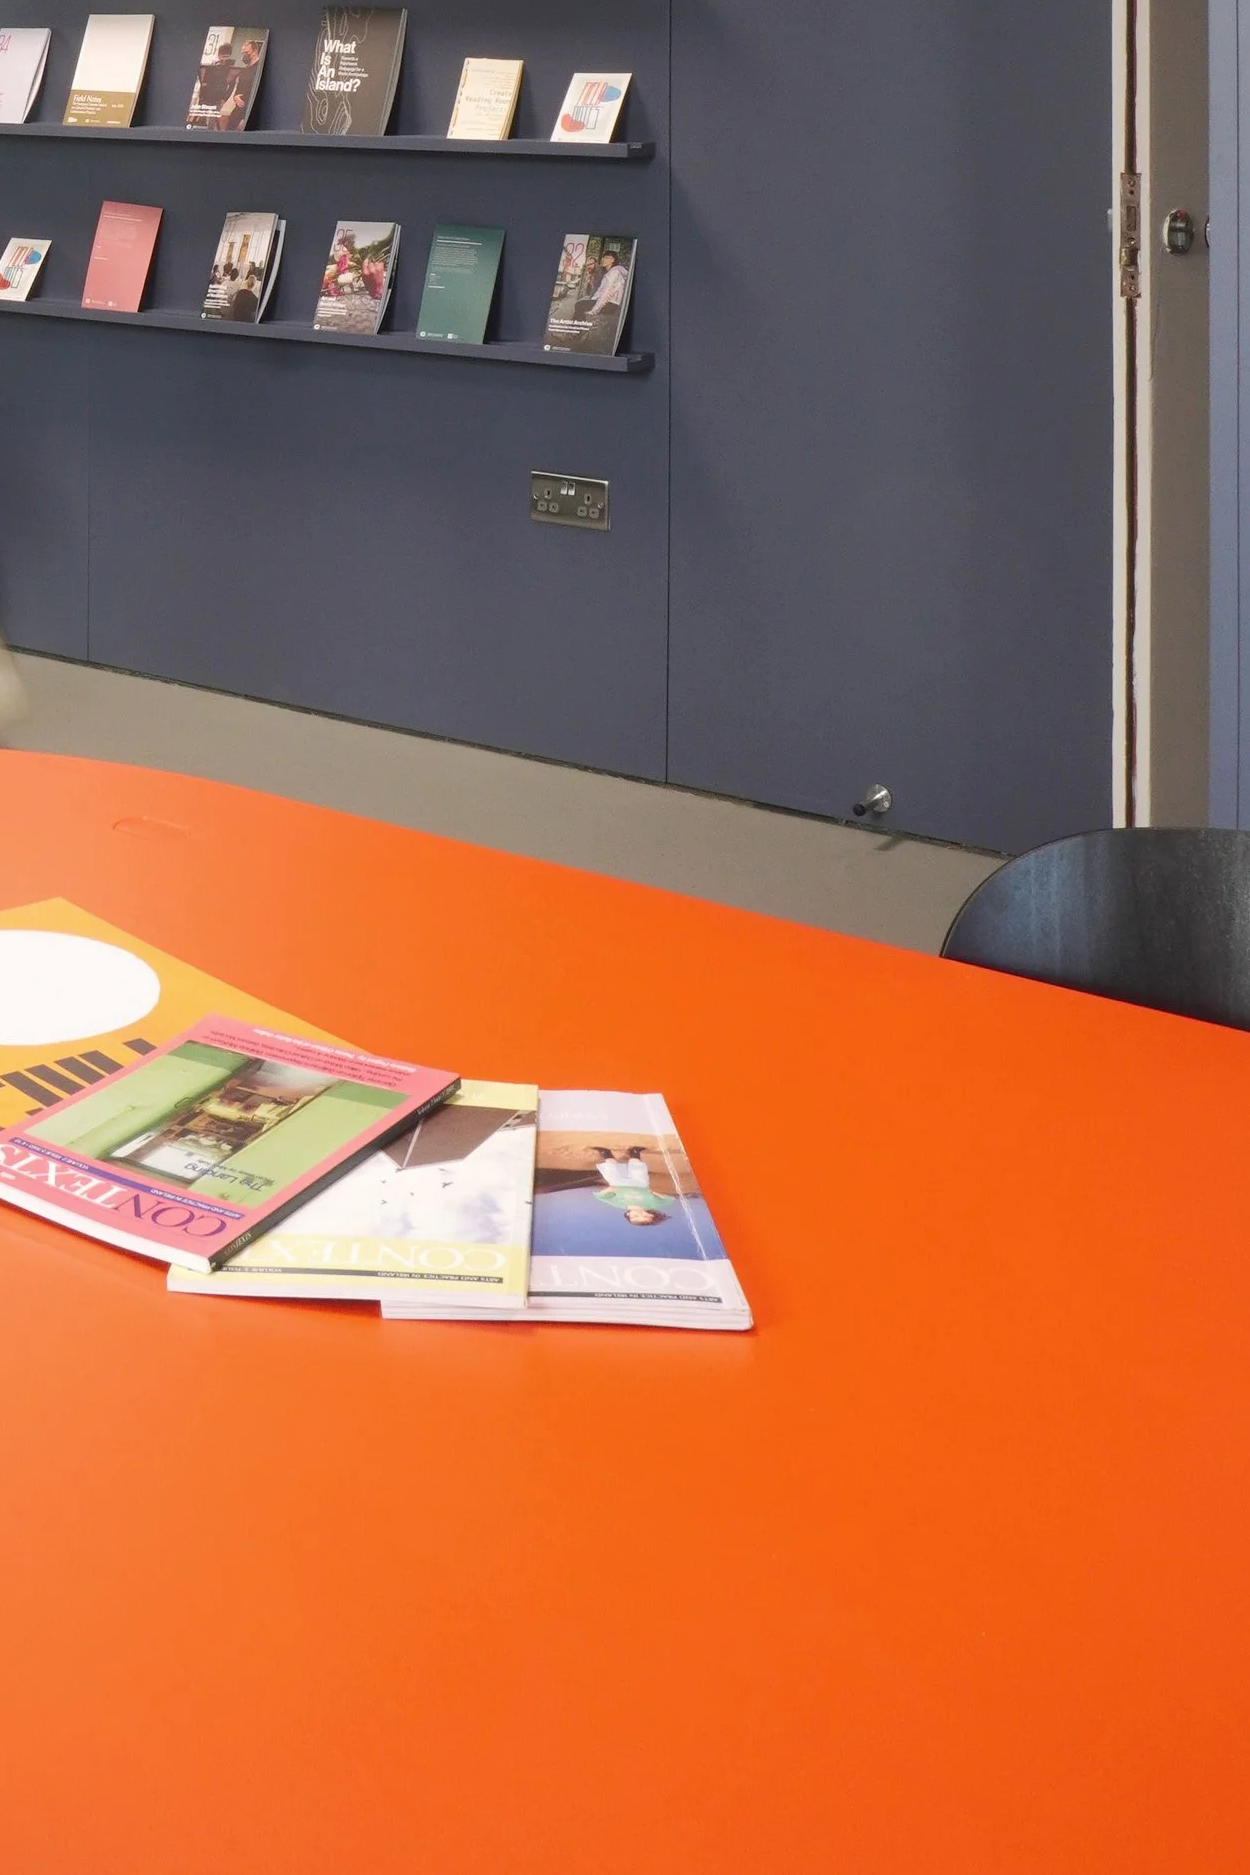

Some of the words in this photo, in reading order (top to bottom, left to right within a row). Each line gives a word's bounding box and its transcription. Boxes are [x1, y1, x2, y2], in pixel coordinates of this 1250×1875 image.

[204, 33, 221, 56] 31
[324, 39, 357, 53] What
[320, 51, 332, 65] Is
[317, 65, 336, 78] An
[315, 77, 362, 92] Island?
[72, 94, 87, 103] Field
[88, 95, 102, 103] Notes
[488, 89, 512, 97] Create
[464, 95, 494, 105] Reading
[184, 1162, 238, 1184] Landing
[239, 1179, 264, 1192] The
[150, 1189, 176, 1200] IRELAND
[183, 1199, 210, 1212] PRACTICE
[211, 1206, 224, 1215] AND
[224, 1211, 241, 1219] ARTS
